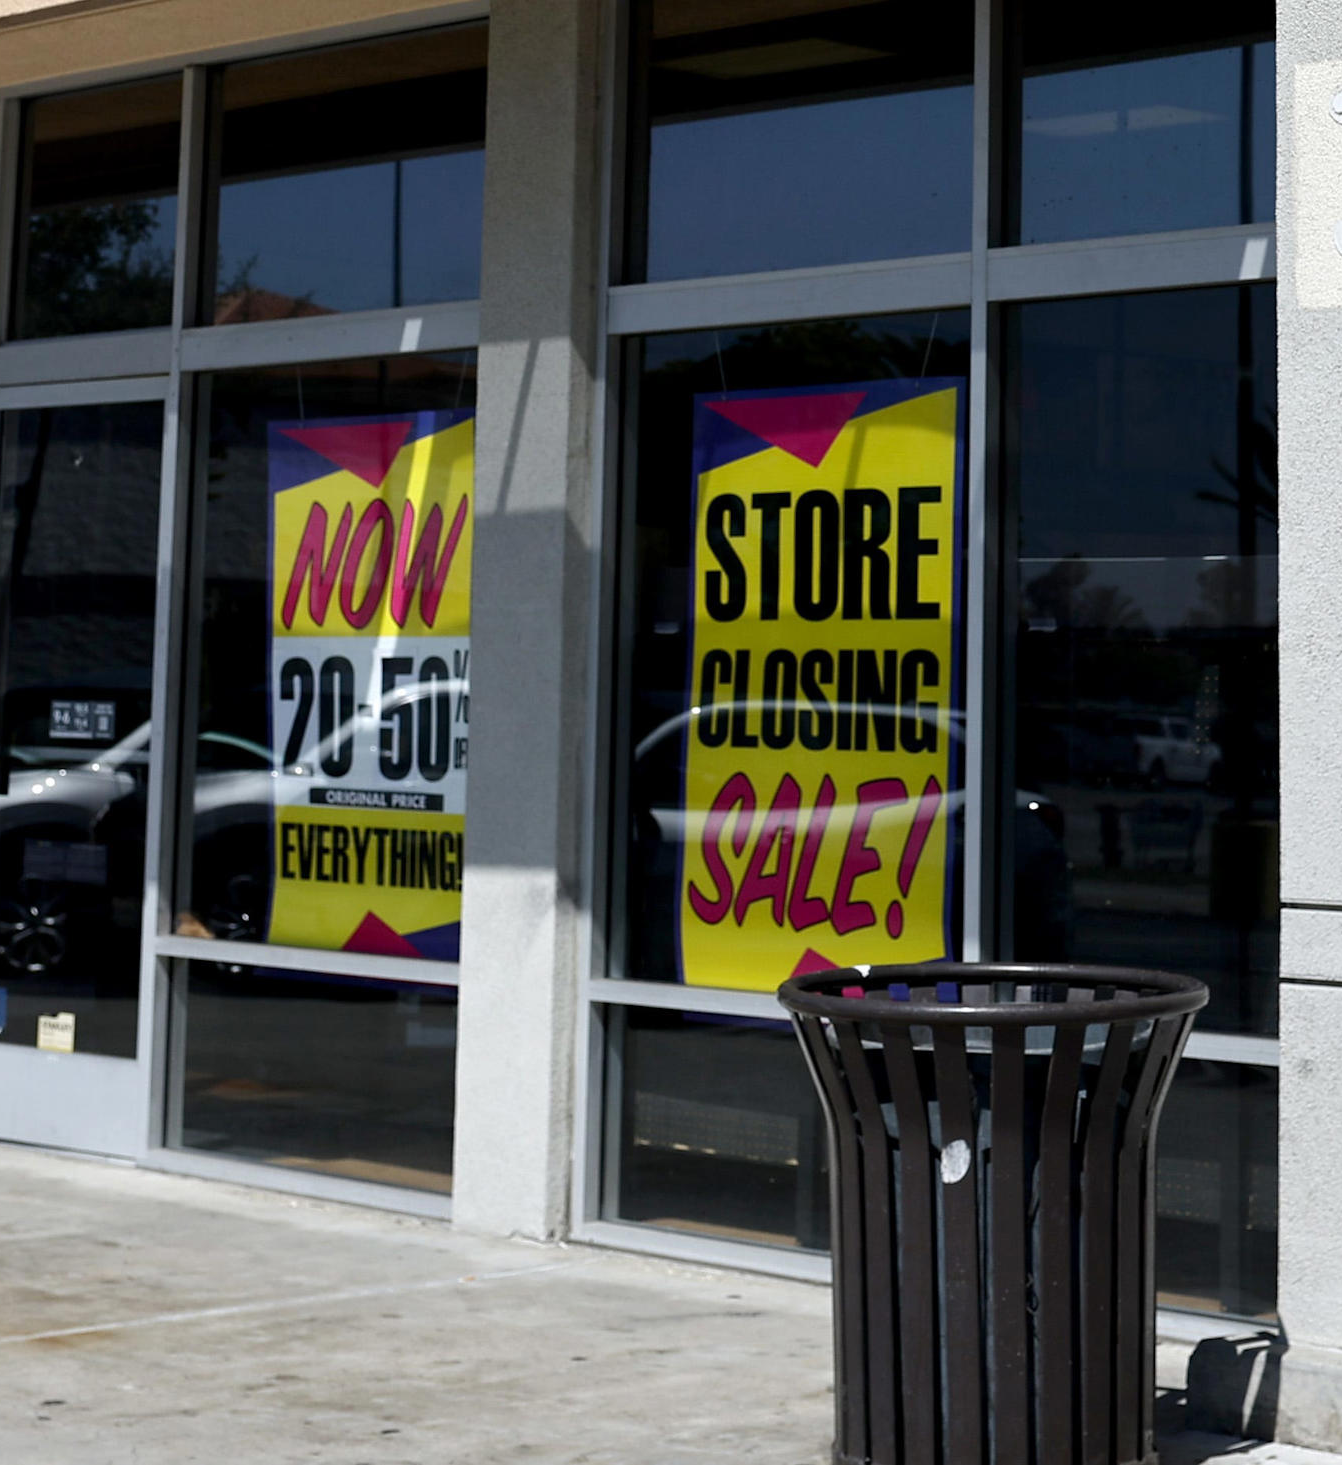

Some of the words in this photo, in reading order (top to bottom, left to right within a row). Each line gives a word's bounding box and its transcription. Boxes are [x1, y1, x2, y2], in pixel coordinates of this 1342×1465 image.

[280, 492, 468, 630] NOW
[703, 485, 943, 623] STORE
[696, 647, 941, 754] CLOSING
[325, 790, 387, 807] ORIGINAL
[390, 793, 428, 809] PRICE
[687, 770, 943, 940] SALE!
